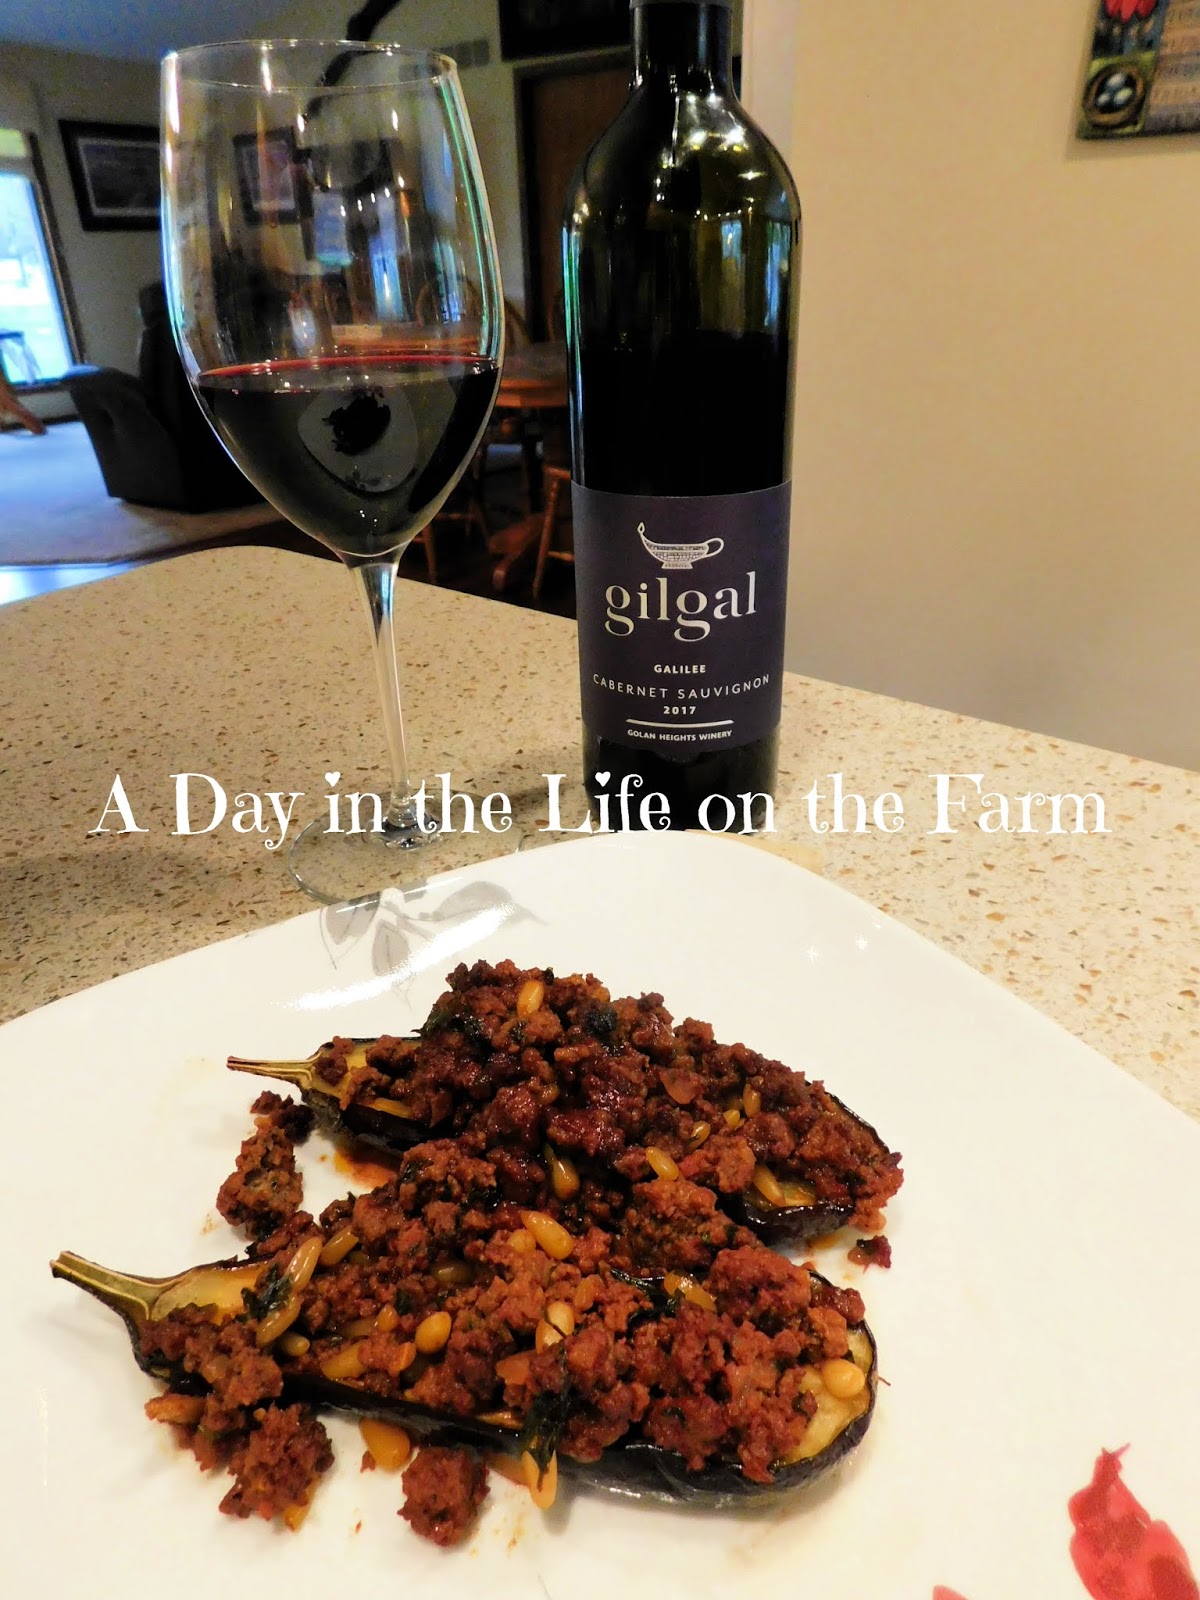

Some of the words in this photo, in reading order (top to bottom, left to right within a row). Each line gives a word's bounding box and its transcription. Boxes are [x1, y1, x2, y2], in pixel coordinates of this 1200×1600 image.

[604, 571, 757, 642] gilgal
[654, 664, 706, 674] GALILEE
[593, 673, 668, 698] CABERNET
[678, 674, 770, 699] SAUVIGNON
[663, 706, 697, 715] 2017
[627, 729, 656, 740] GOLAN
[659, 732, 696, 741] HEIGHTS
[699, 729, 733, 741] WINERY
